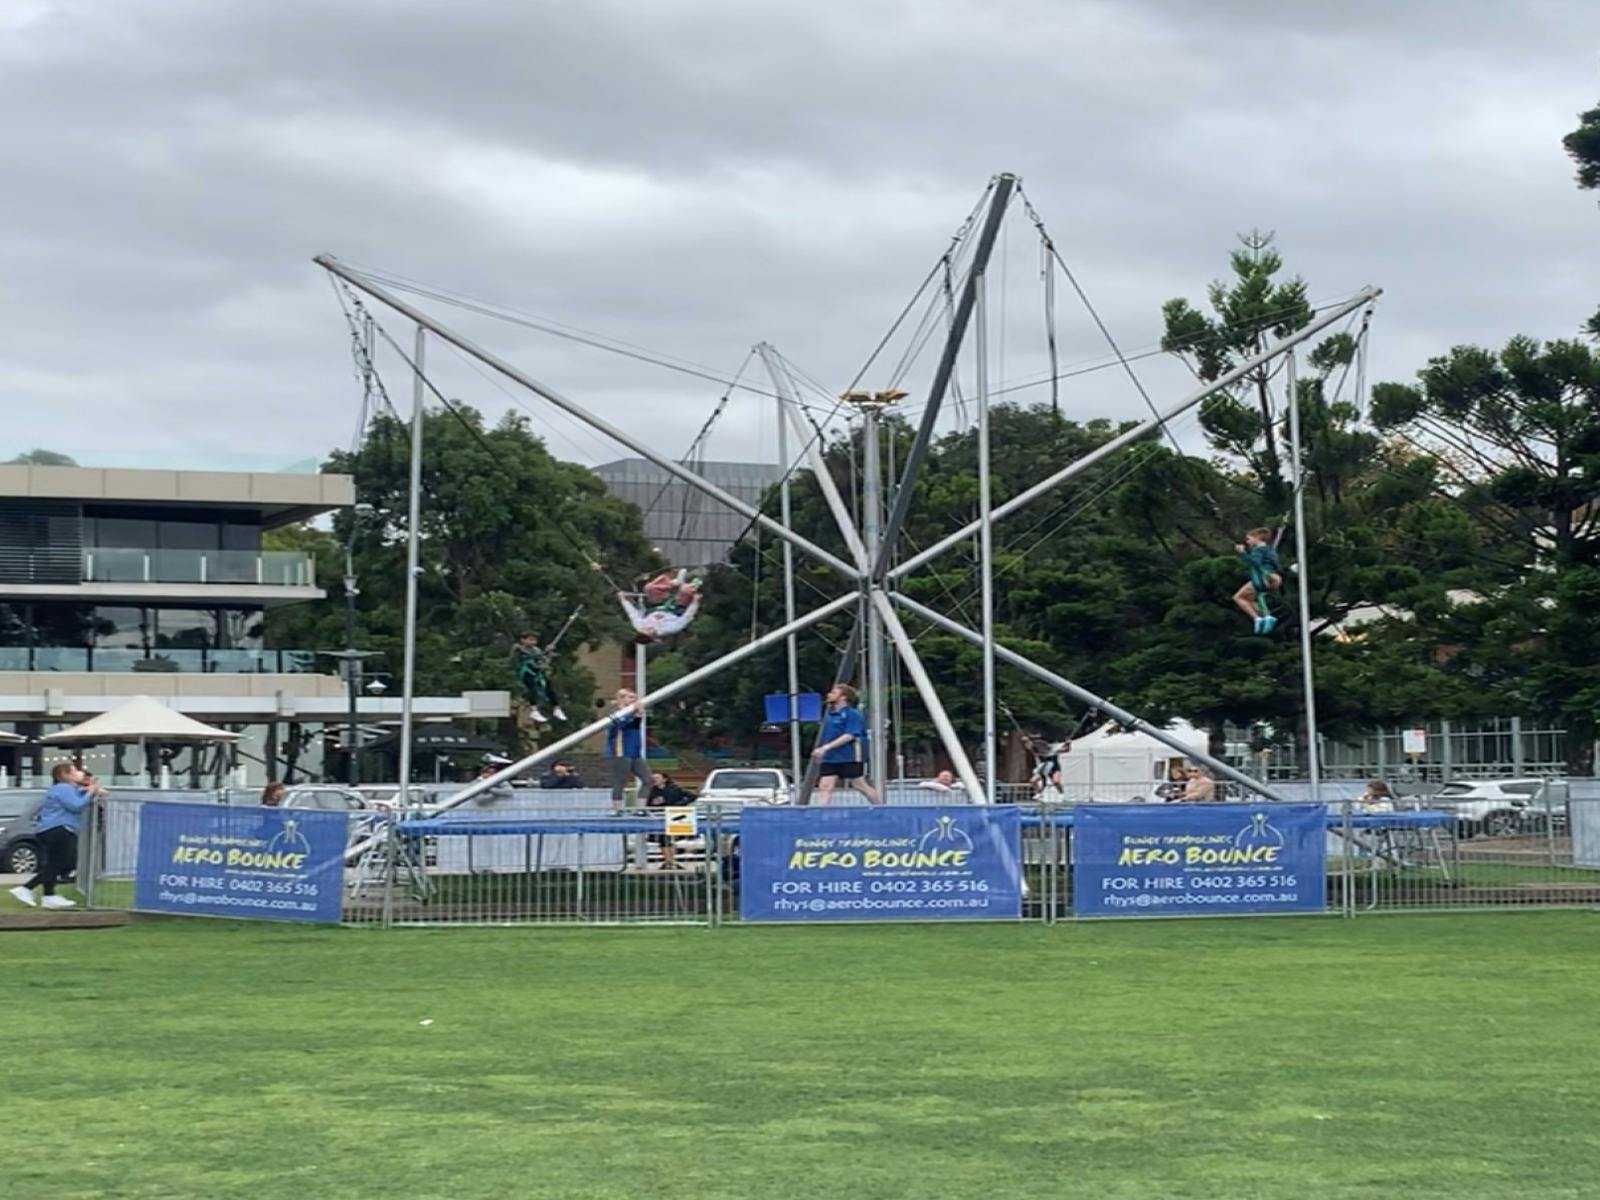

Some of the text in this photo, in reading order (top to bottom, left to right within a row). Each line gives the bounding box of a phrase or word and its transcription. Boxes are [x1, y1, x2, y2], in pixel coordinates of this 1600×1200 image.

[172, 845, 308, 870] AERO BOUNCE
[790, 848, 972, 869] AERO BOUNCE
[1118, 844, 1282, 867] AERO BOUNCE
[159, 874, 319, 896] FOR HIRE 0402 365 516
[772, 880, 988, 894] FOR HIRE 0402 365 516
[1102, 874, 1297, 890] FOR HIRE 0402 365 516
[774, 898, 989, 912] rhys@aerobounce.com.au
[1104, 893, 1298, 907] rhys@aerobounce.com.au
